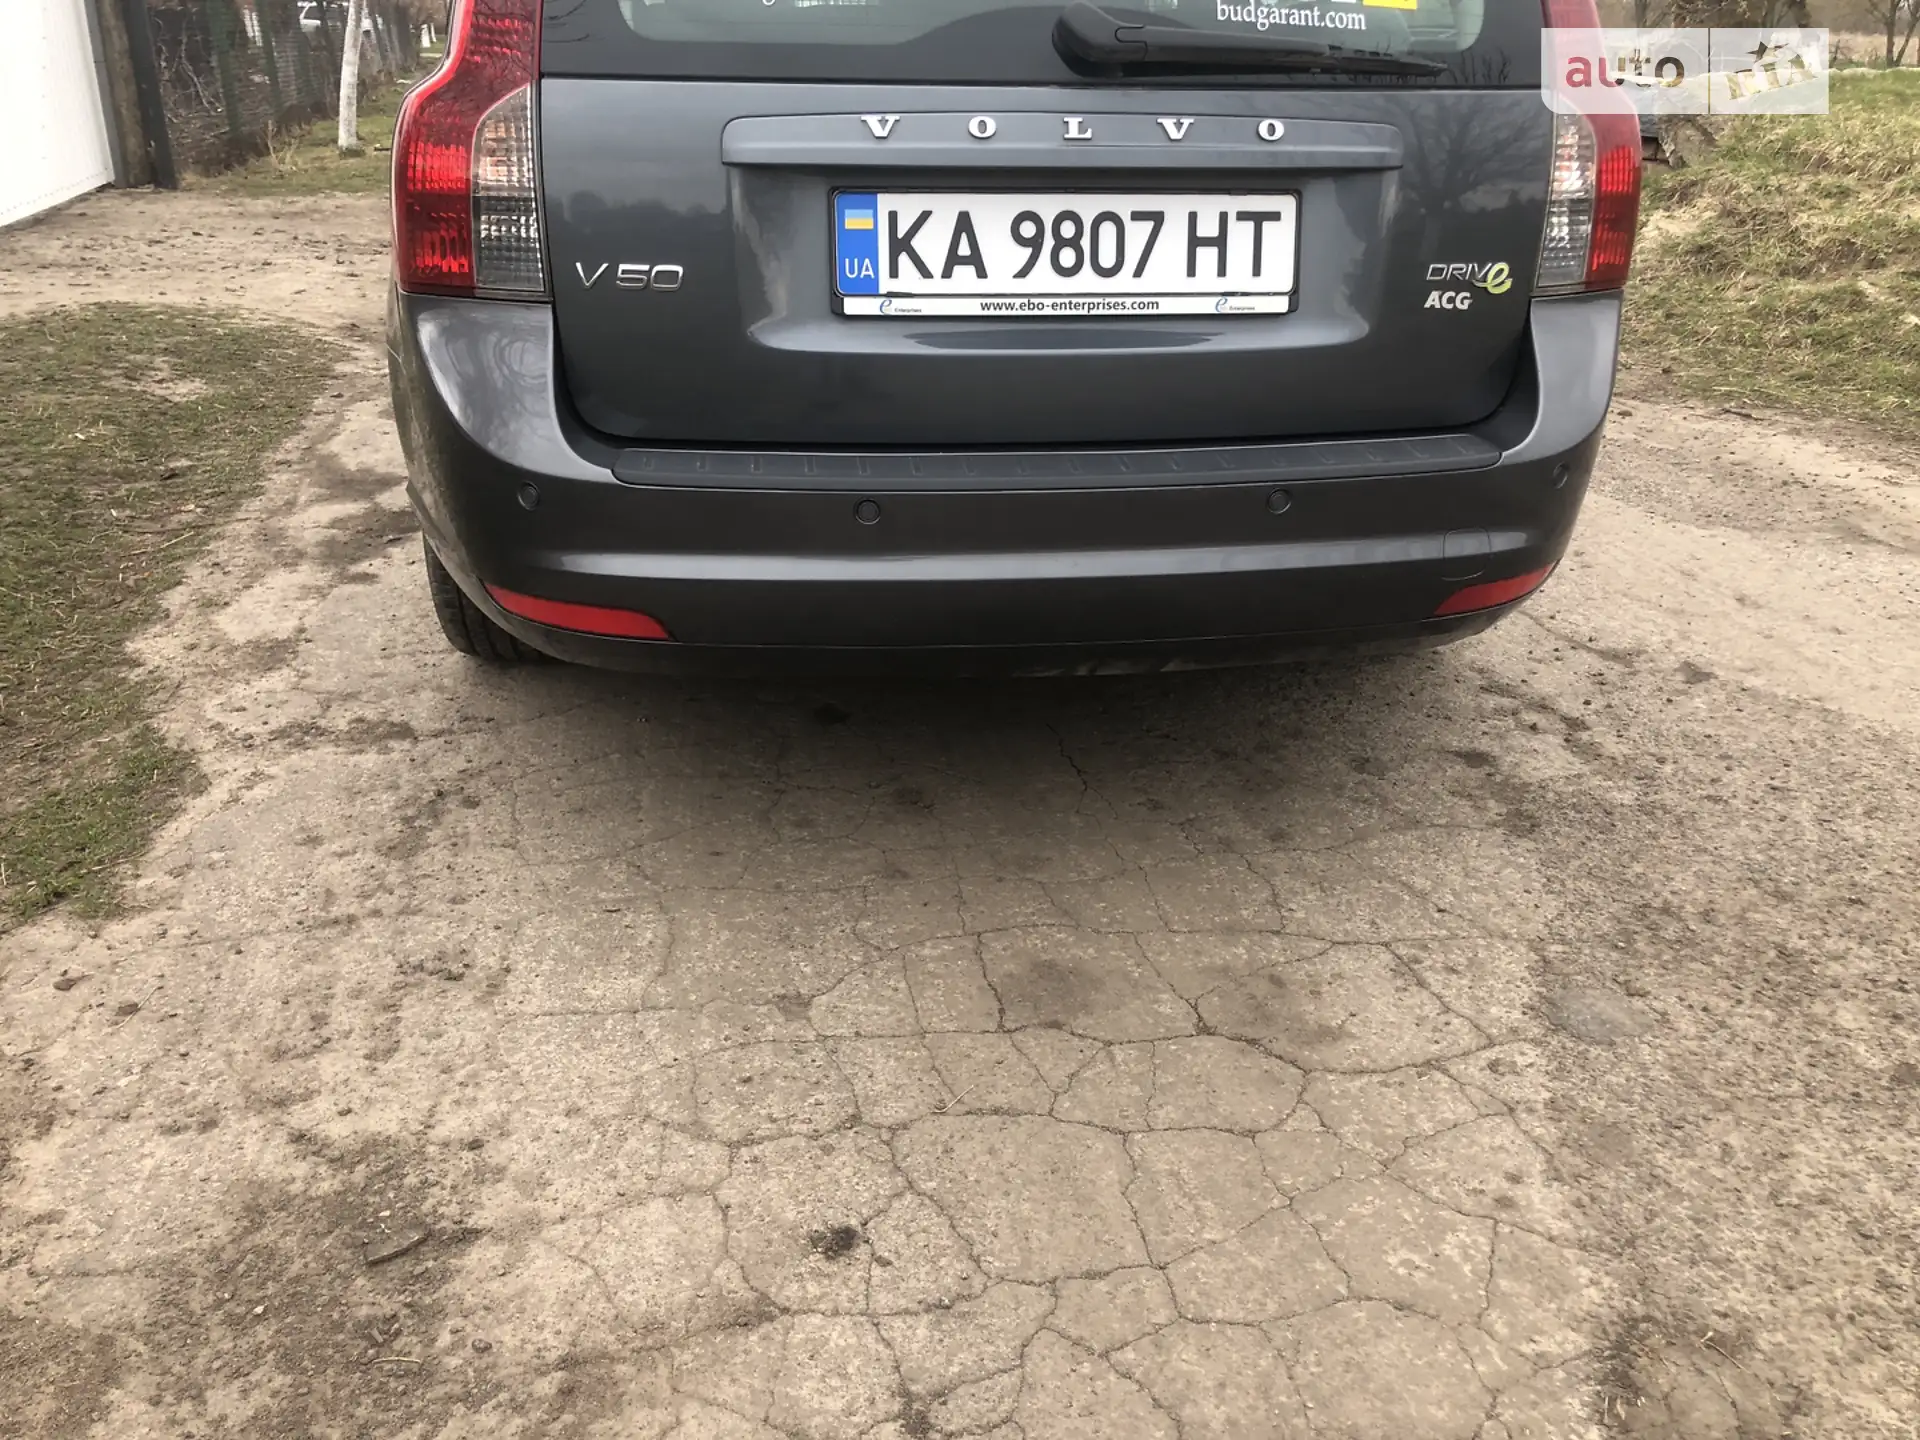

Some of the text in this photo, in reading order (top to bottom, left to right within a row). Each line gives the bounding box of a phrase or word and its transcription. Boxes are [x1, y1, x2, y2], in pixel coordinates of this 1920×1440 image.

[1216, 0, 1367, 31] budgarant.com
[860, 115, 1286, 142] VOLVO
[888, 210, 1283, 280] KA 9807 HT
[844, 258, 875, 279] UA
[980, 299, 1160, 313] www.ebo-enterprises.com
[1424, 290, 1473, 310] ACG
